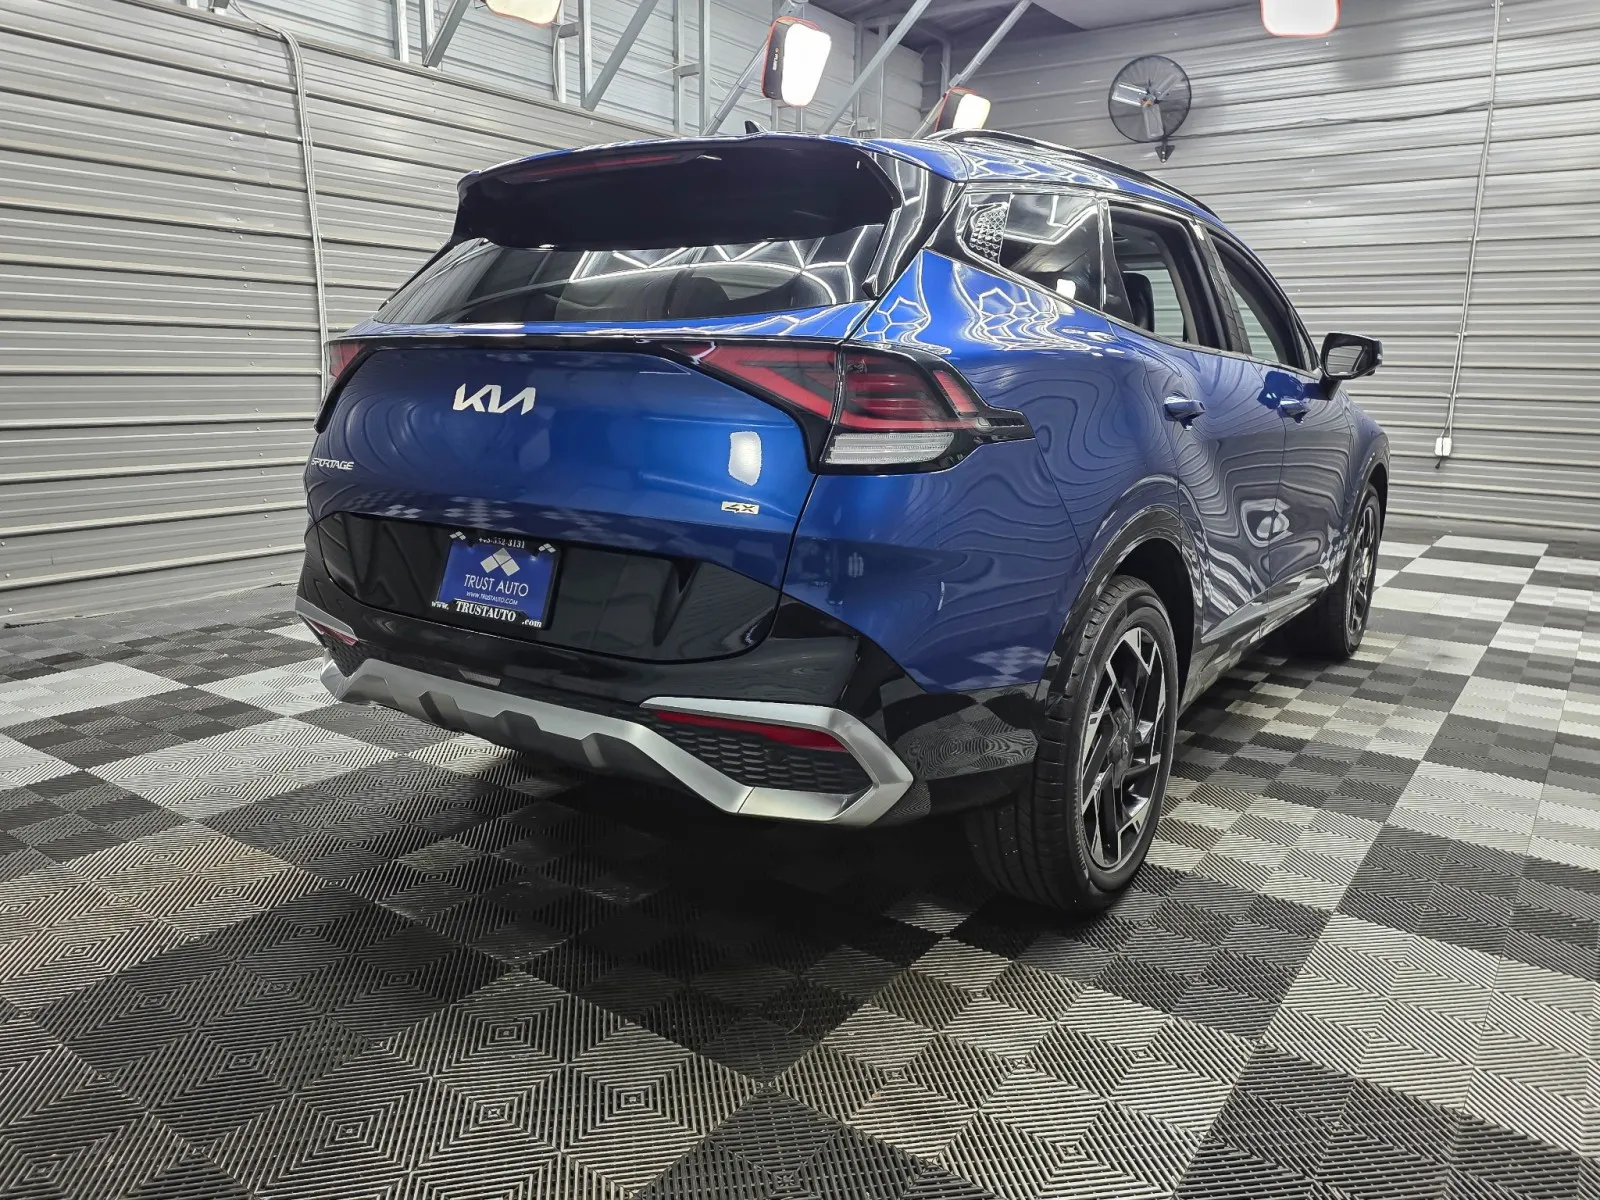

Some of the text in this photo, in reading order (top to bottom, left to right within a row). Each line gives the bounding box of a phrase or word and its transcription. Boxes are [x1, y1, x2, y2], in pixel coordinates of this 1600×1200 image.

[453, 383, 536, 416] KIA
[310, 457, 355, 470] SPORTAGE
[463, 574, 529, 597] TRUST AUTO
[466, 591, 518, 605] WWW.TRUSTAUTO.COM
[455, 600, 517, 622] TRUSTAUTO
[521, 618, 542, 628] .com
